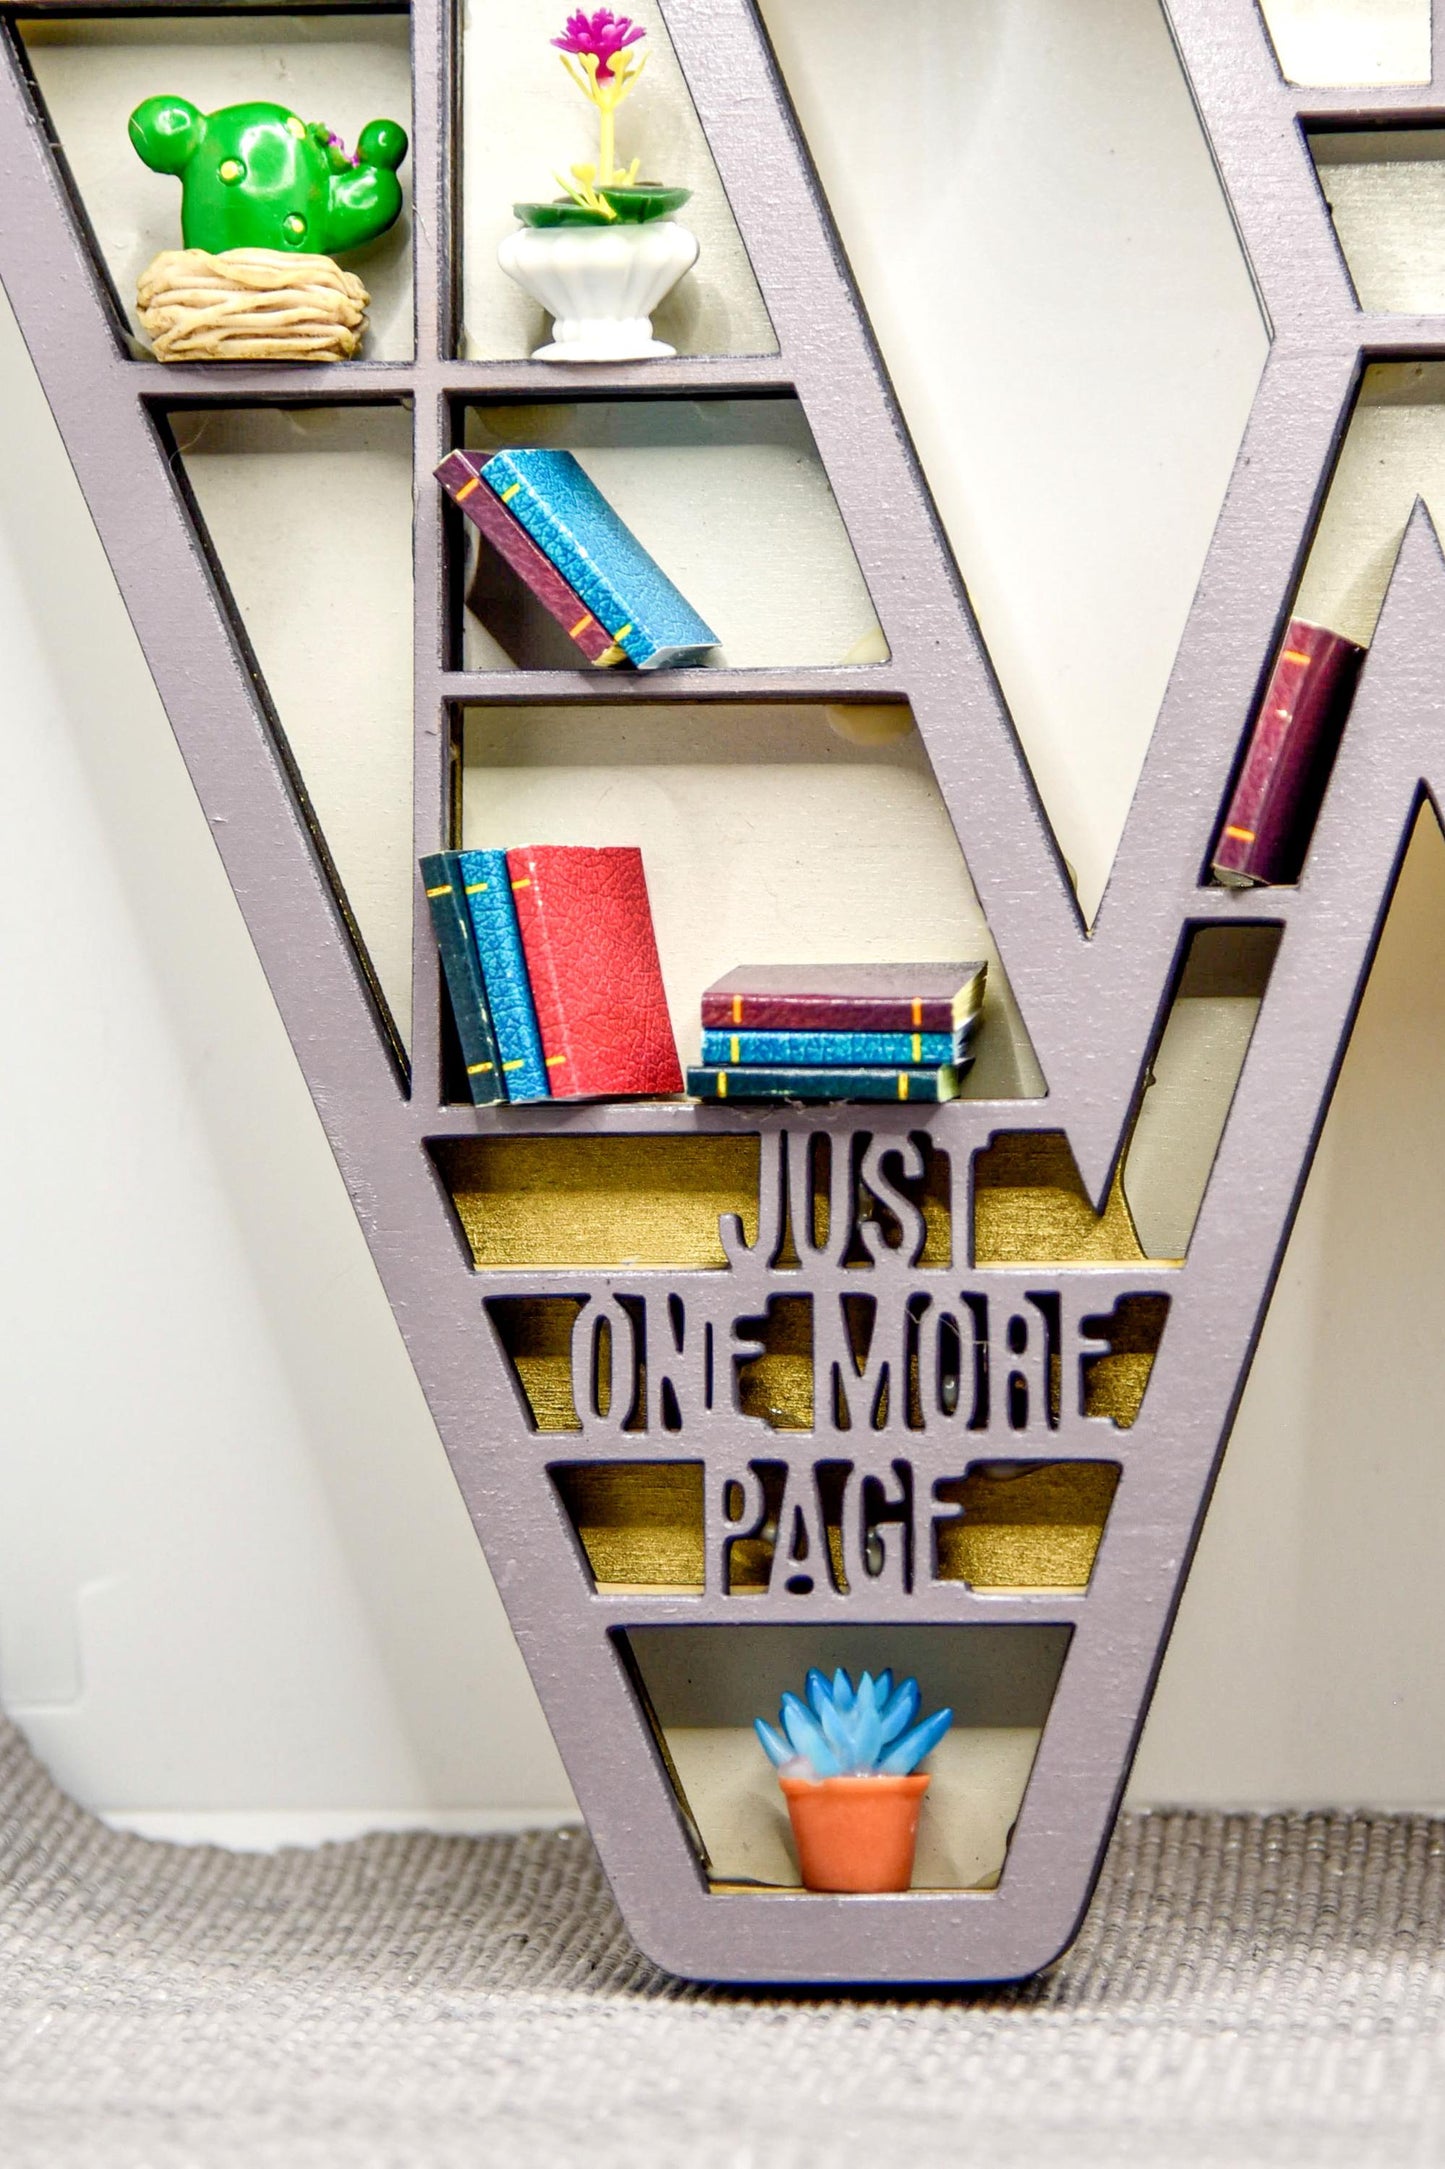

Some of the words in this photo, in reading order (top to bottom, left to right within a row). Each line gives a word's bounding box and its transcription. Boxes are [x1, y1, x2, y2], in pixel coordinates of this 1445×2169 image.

[720, 1128, 994, 1270] JUST
[572, 1292, 768, 1432] ONE
[812, 1291, 1118, 1432] MORE
[704, 1459, 968, 1595] PAGE
